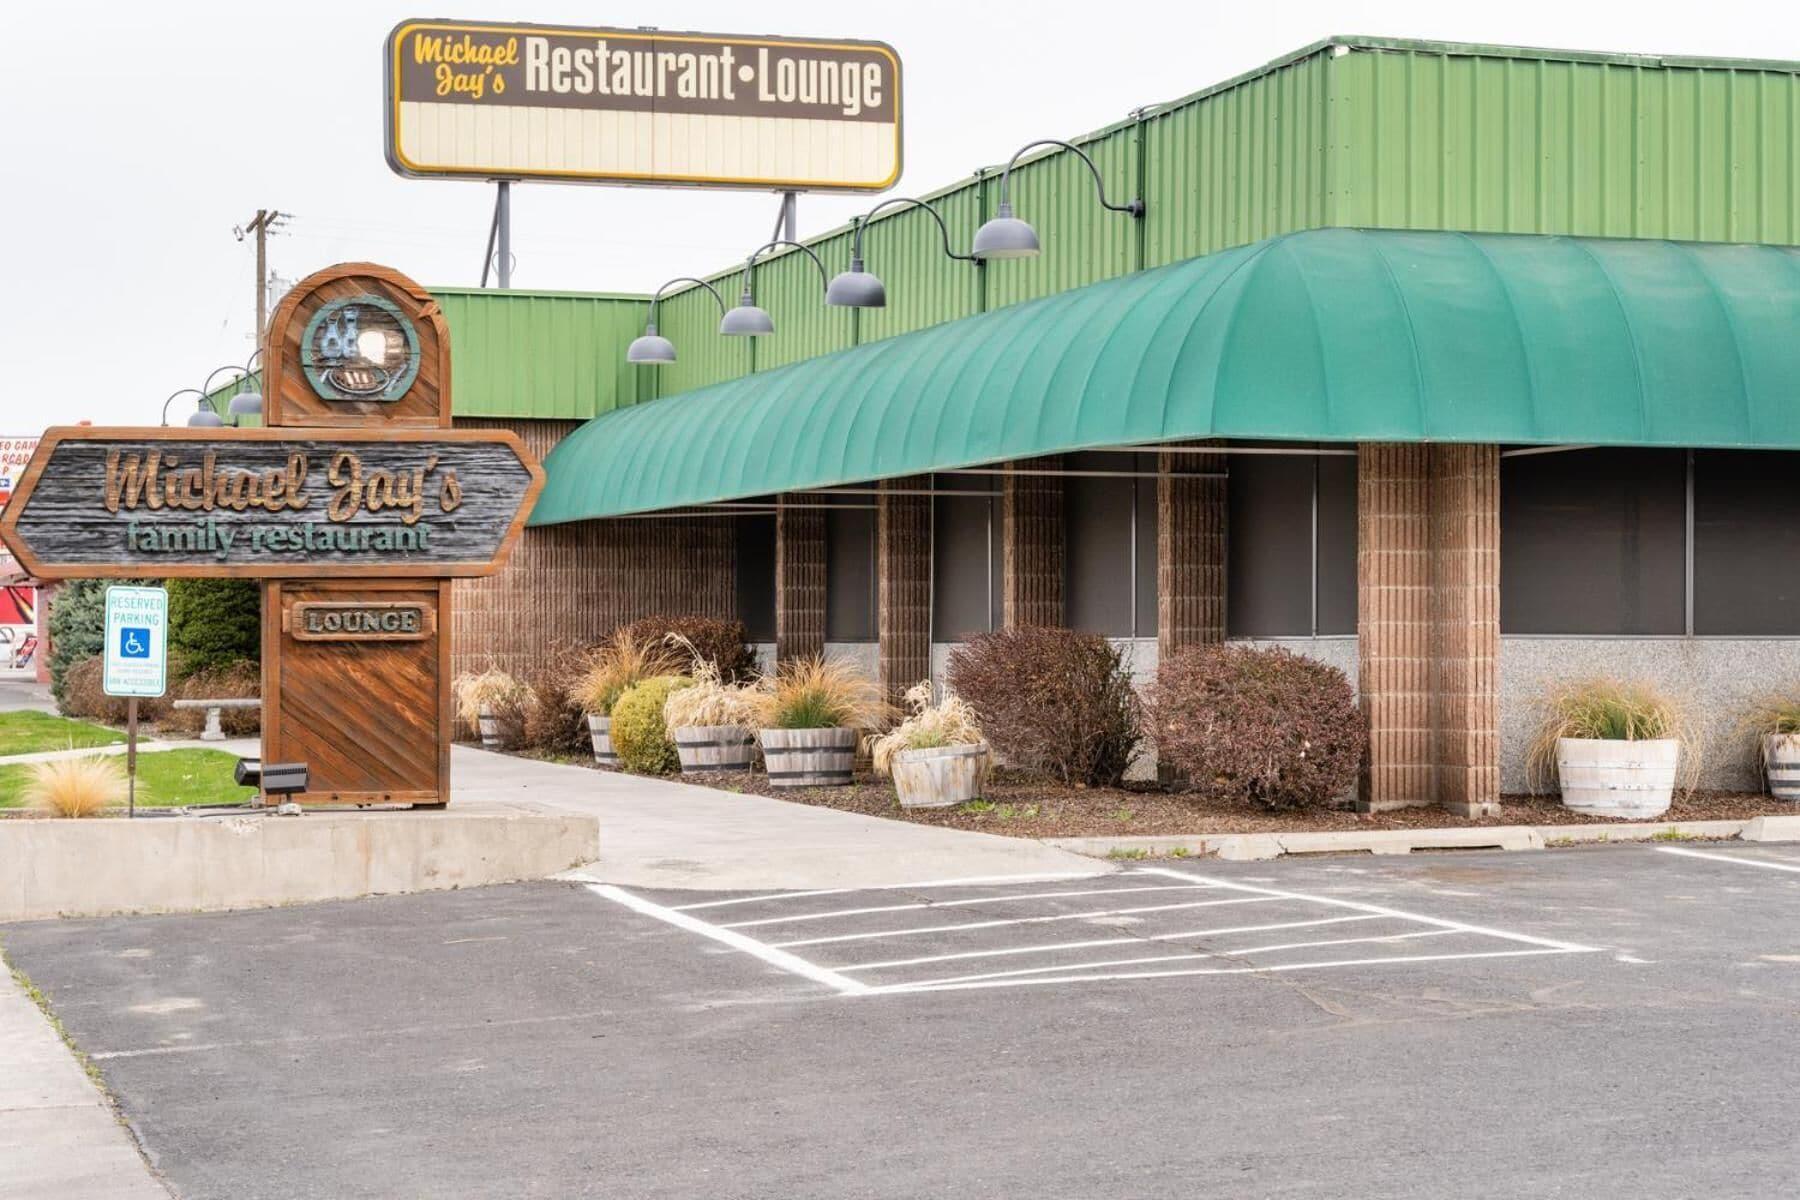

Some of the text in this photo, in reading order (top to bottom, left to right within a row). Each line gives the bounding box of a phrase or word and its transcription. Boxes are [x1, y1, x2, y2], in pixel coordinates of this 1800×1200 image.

[414, 33, 520, 65] Michael
[435, 63, 505, 99] Jay's
[526, 37, 882, 116] Restaurant Lounge
[104, 449, 463, 524] Michael Jay's
[127, 518, 432, 559] family restaurant
[110, 597, 163, 610] RESERVED
[114, 613, 159, 626] PARKING
[308, 610, 418, 632] LOUNGE
